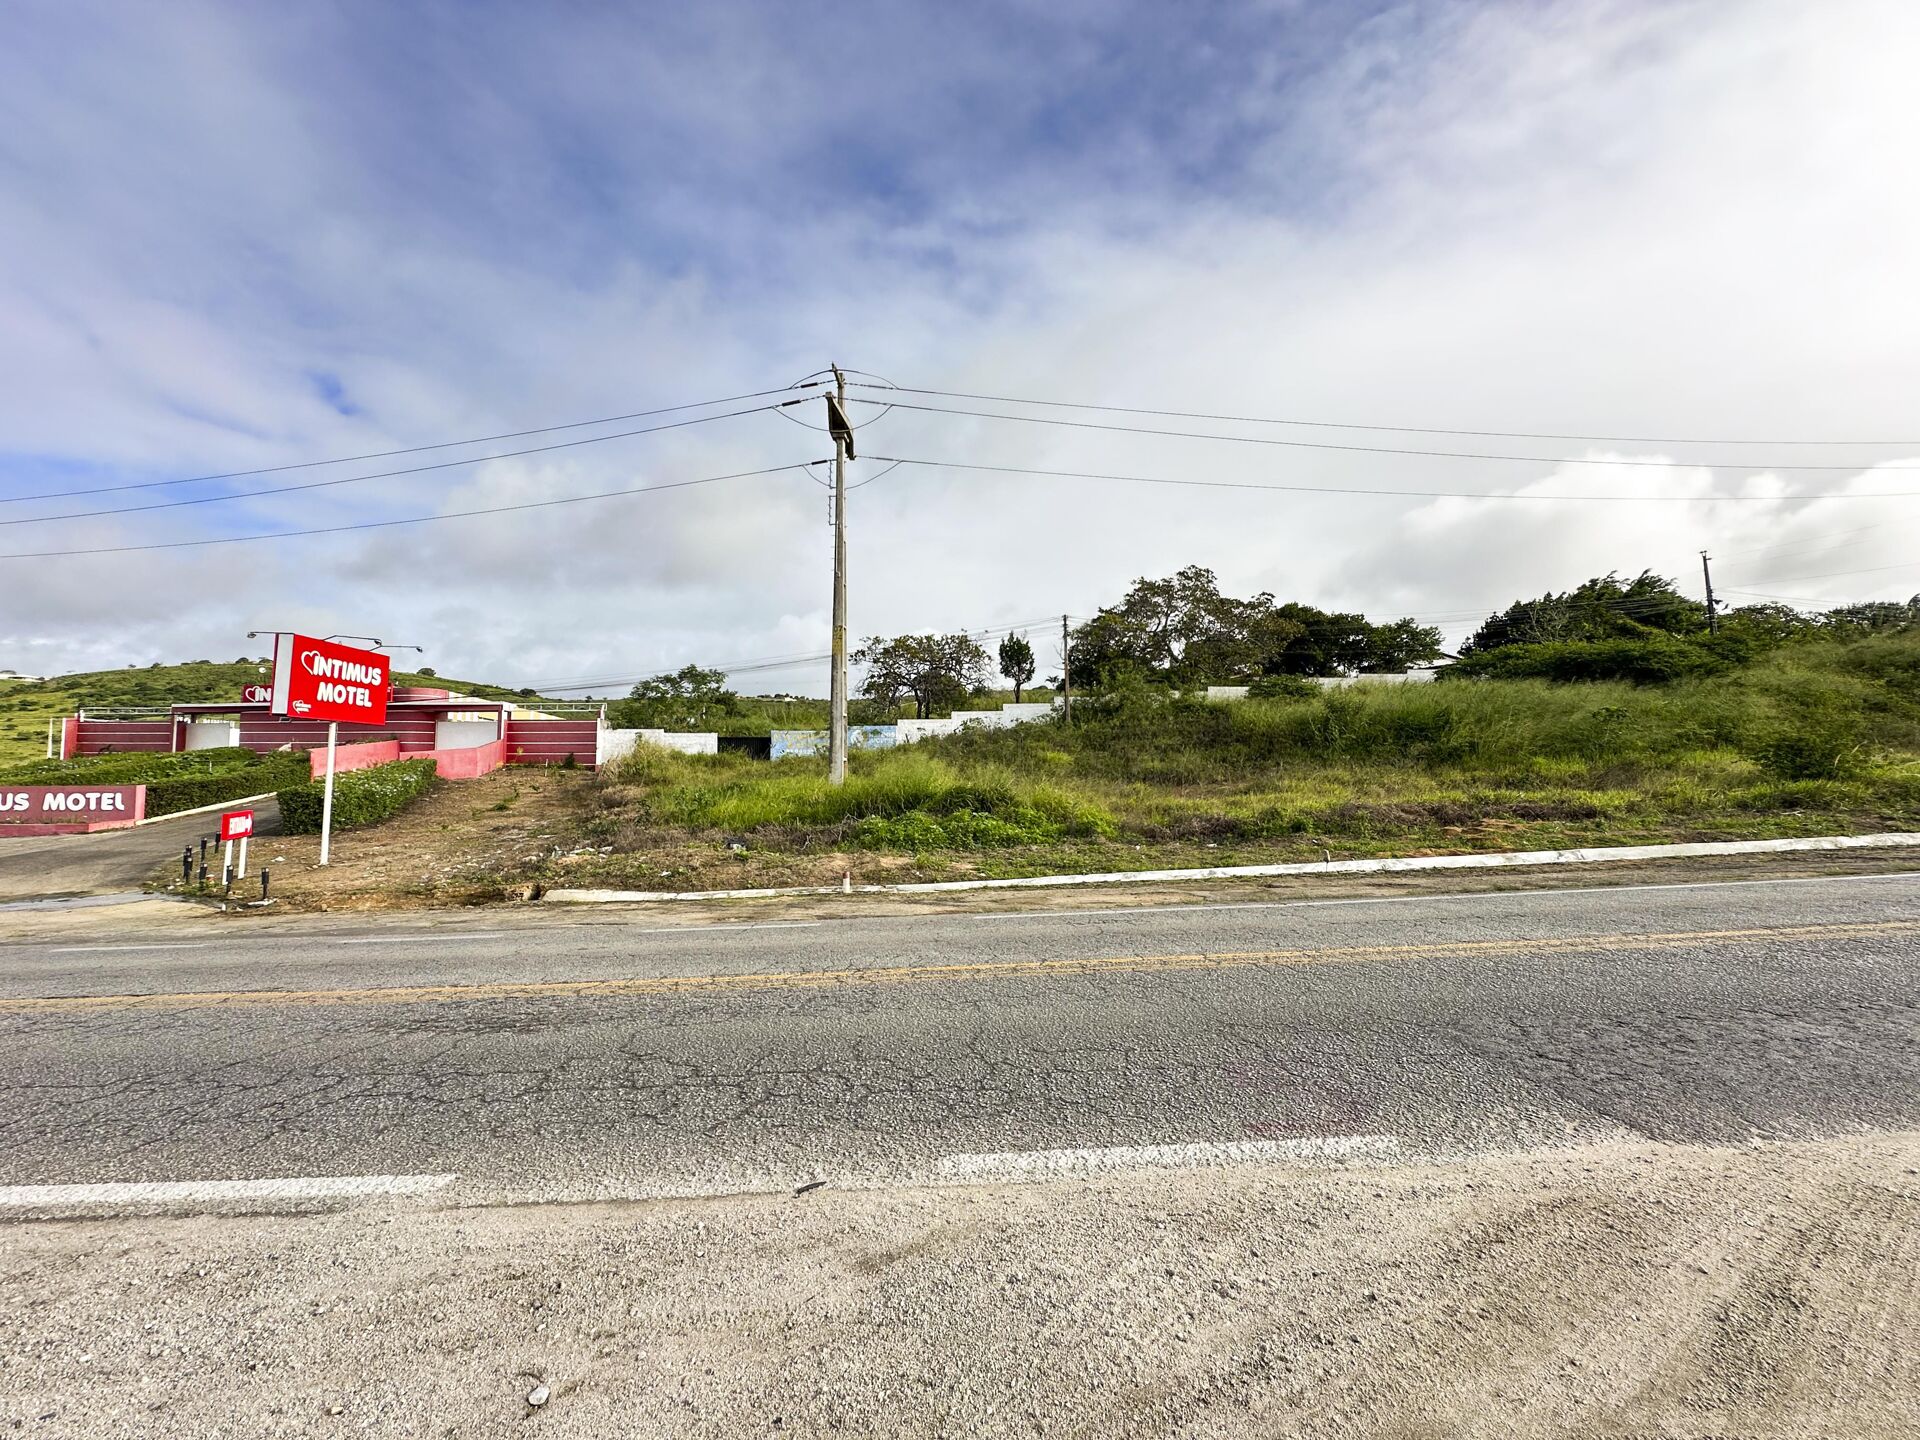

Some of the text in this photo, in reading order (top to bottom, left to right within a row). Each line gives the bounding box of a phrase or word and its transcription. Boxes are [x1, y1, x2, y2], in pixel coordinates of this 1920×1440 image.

[313, 655, 382, 686] INTIMUS
[316, 682, 373, 708] MOTEL
[42, 792, 125, 811] MOTEL
